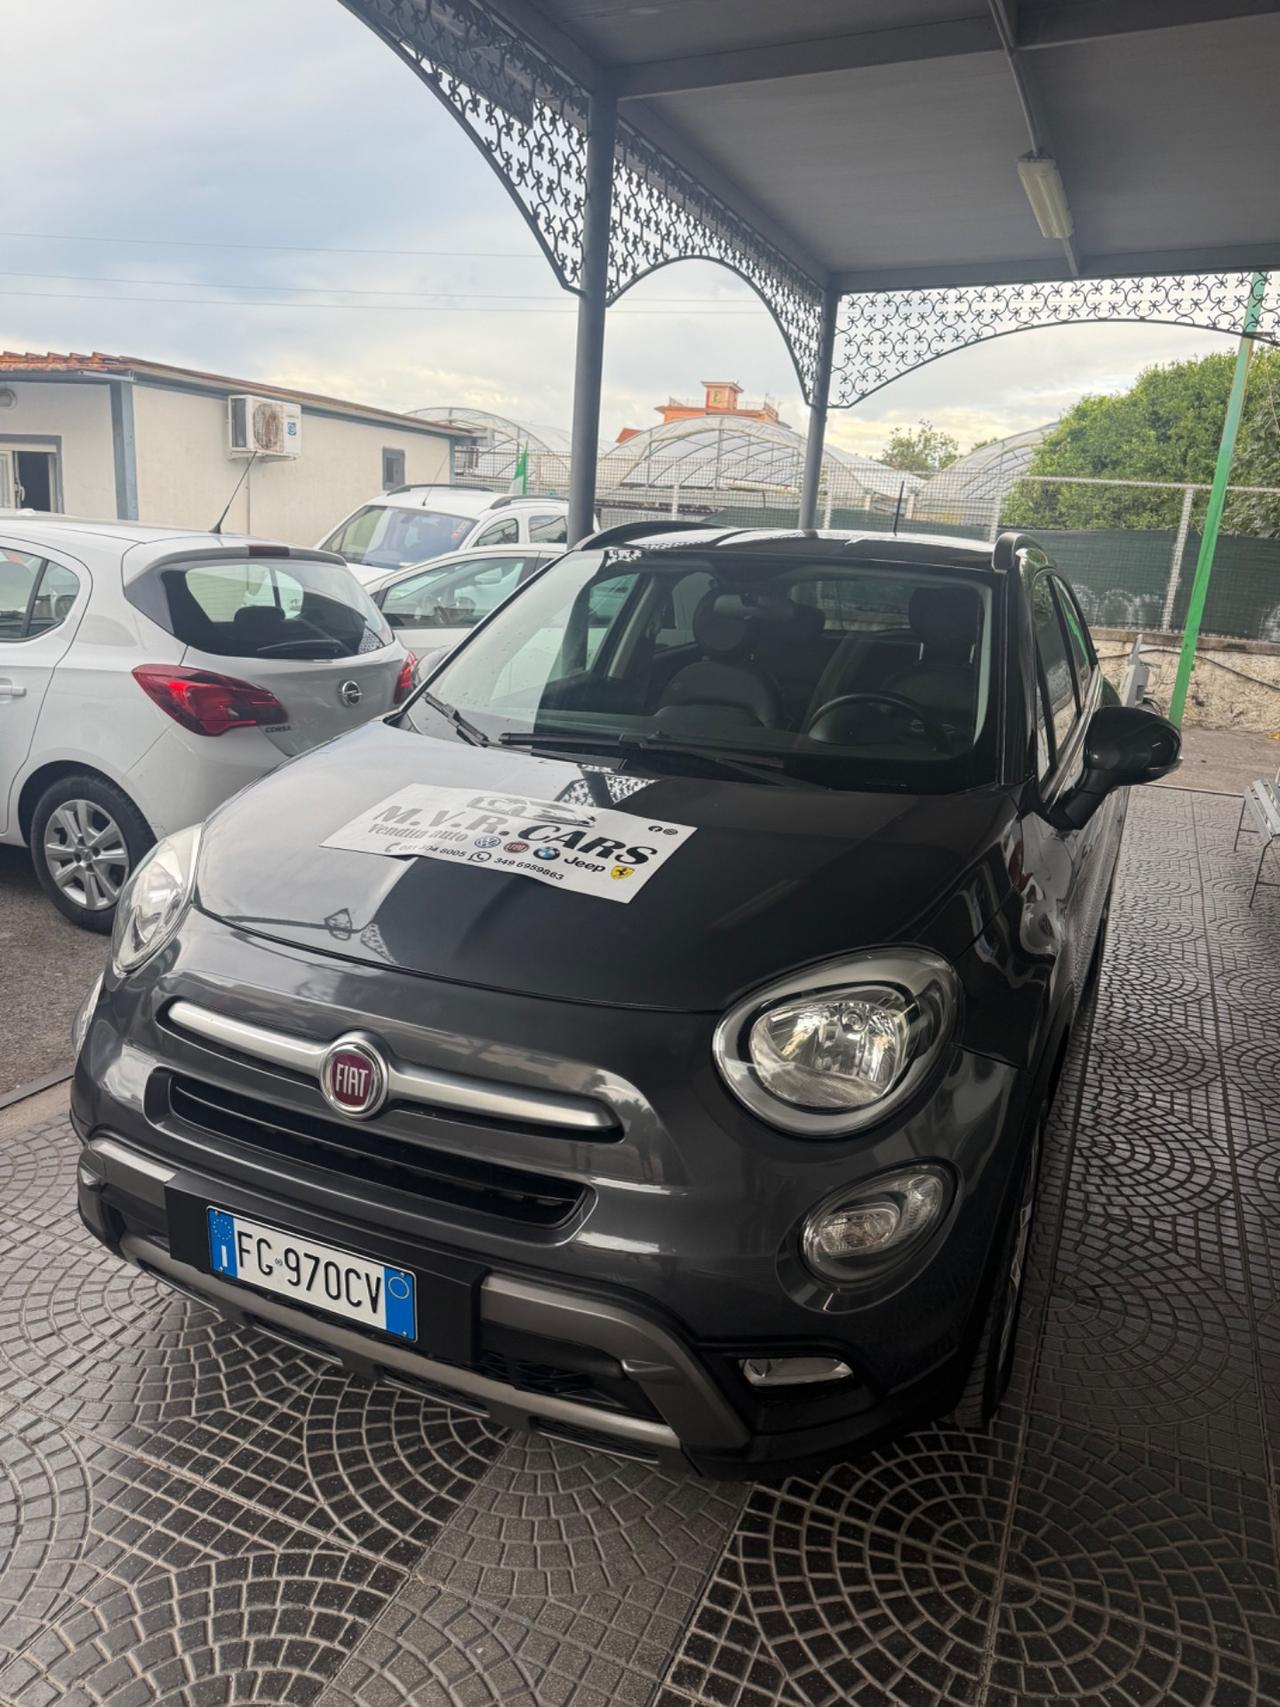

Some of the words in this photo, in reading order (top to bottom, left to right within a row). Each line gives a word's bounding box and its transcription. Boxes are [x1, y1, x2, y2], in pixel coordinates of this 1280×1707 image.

[368, 823, 429, 839] Vendita
[428, 829, 469, 842] auto
[372, 805, 510, 836] M.V.R.
[517, 824, 659, 865] CARS
[494, 857, 516, 866] 349
[516, 861, 564, 881] 6959863
[563, 856, 606, 873] Jeep
[335, 1063, 369, 1097] FIAT
